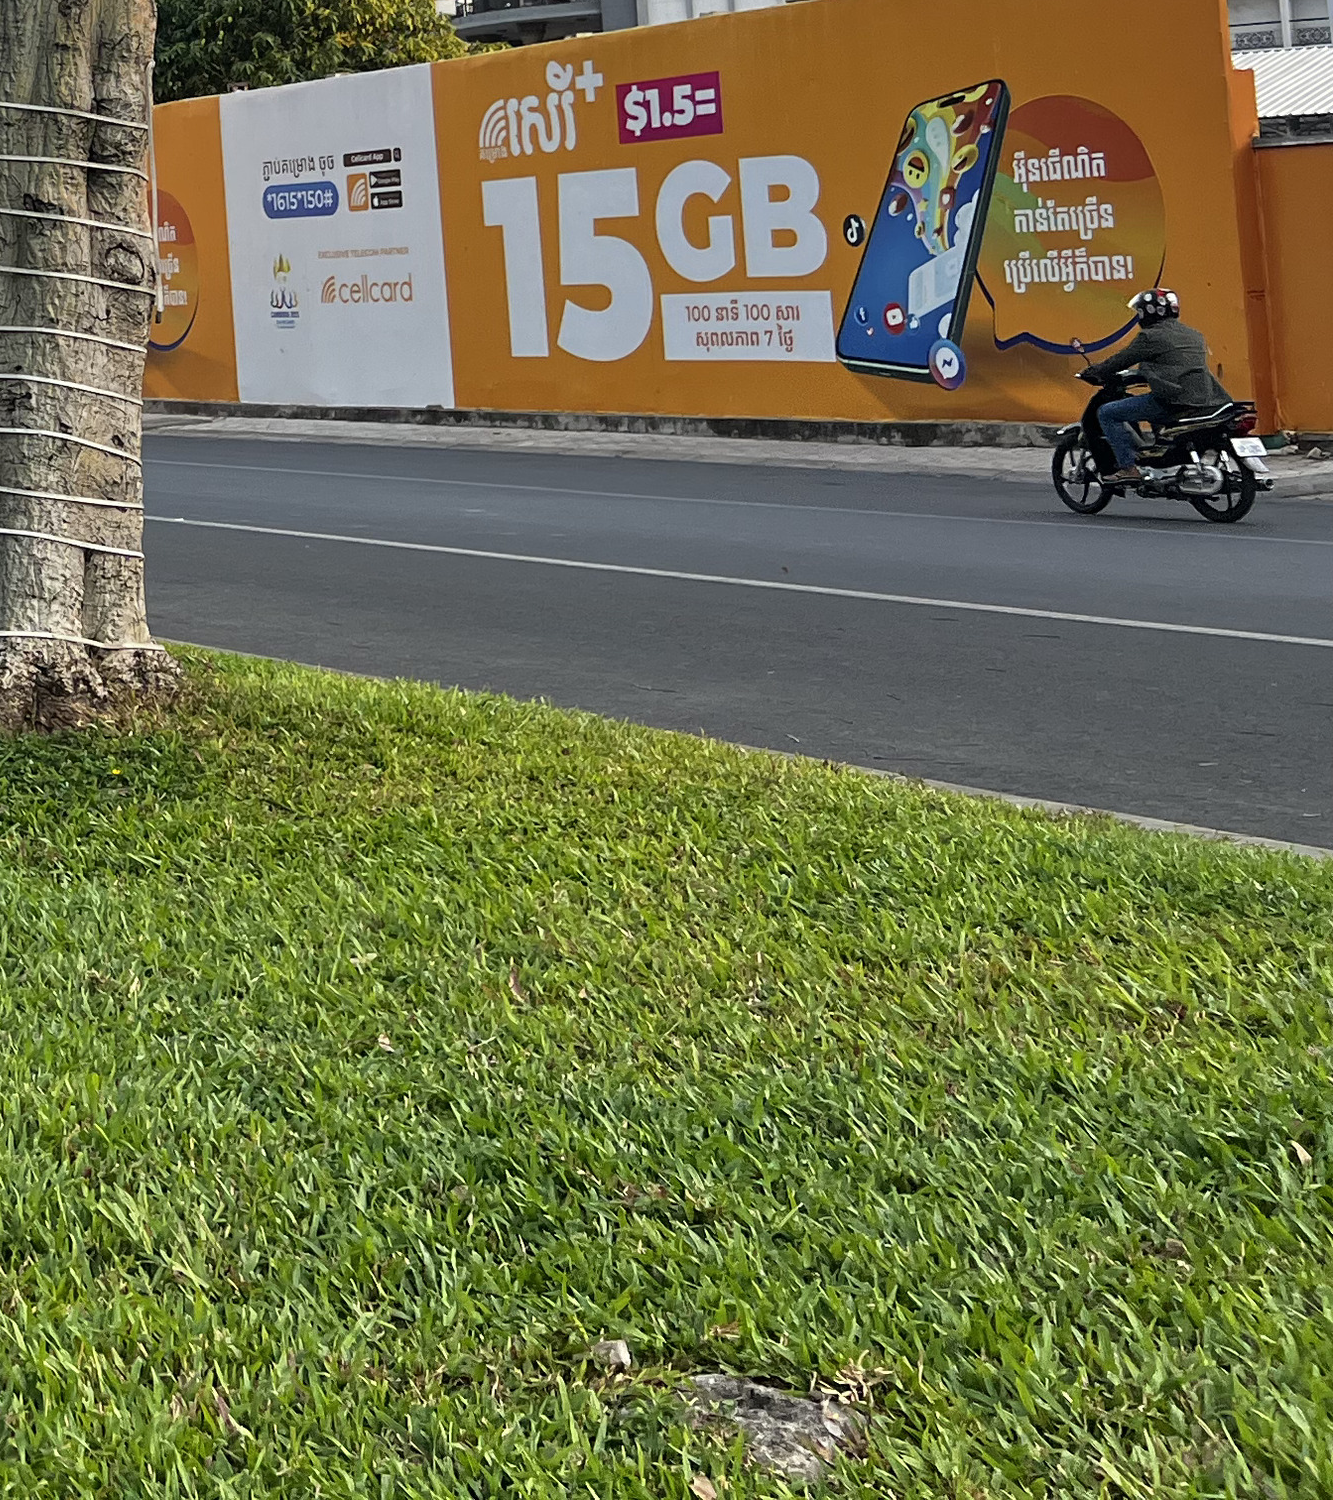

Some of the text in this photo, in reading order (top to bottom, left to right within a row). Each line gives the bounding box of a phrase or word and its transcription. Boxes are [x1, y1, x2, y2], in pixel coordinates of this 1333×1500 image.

[1014, 196, 1115, 240] កាន់តែច្រើន
[338, 272, 413, 303] cellcard
[685, 306, 711, 322] 100
[743, 304, 770, 321] 100
[764, 330, 773, 347] 7
